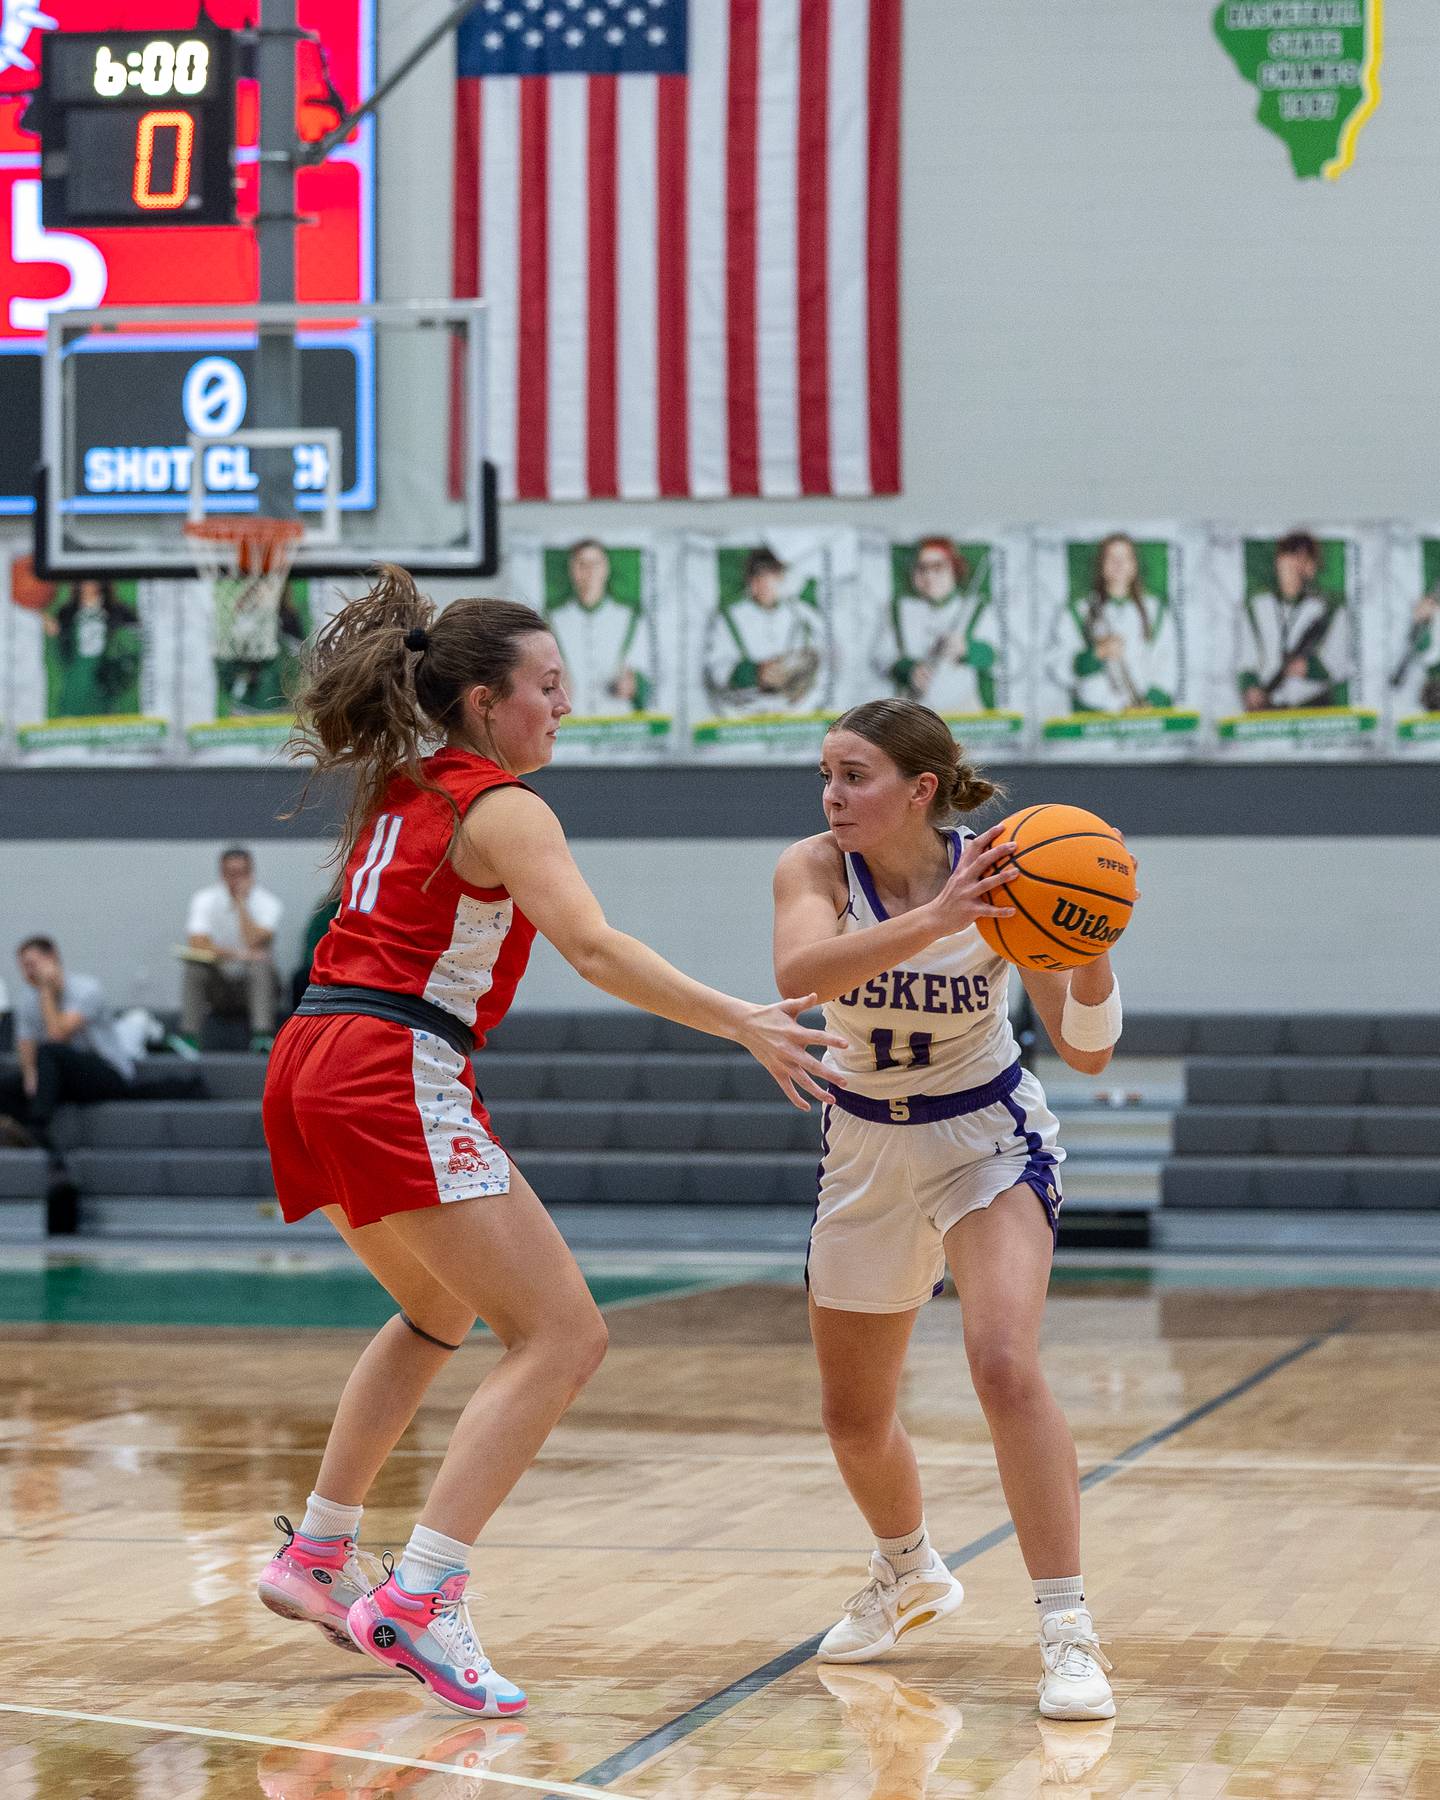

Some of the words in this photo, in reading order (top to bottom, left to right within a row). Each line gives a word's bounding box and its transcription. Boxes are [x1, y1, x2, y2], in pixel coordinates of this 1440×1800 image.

[94, 41, 208, 95] 6:00
[133, 111, 194, 209] 0
[9, 178, 108, 330] 5
[182, 355, 248, 438] 0
[84, 446, 195, 492] SHOT
[203, 444, 330, 491] CLCK
[348, 813, 404, 914] 11
[1052, 896, 1127, 943] Wilso
[832, 970, 990, 1014] USKERS
